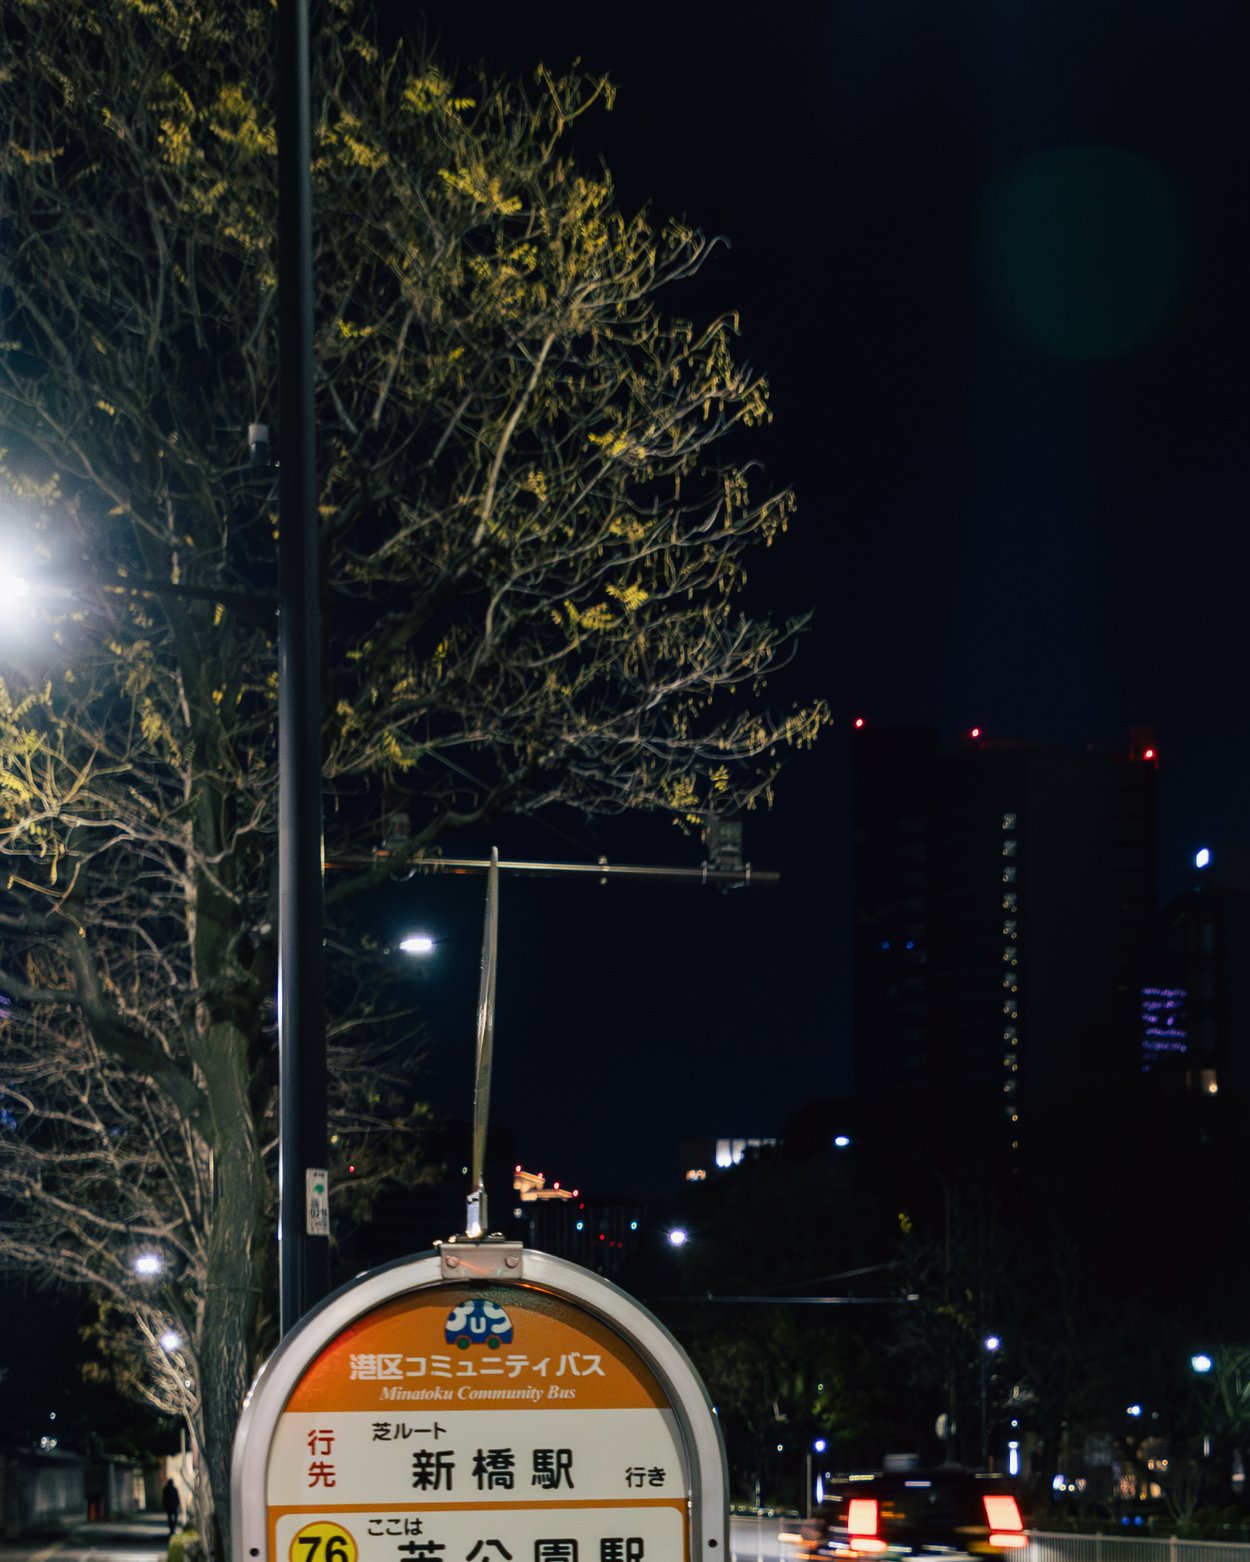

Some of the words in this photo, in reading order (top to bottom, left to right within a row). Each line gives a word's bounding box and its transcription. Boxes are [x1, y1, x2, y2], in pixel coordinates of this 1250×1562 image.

[349, 1353, 605, 1380] 港区コミュニティバス
[379, 1386, 453, 1401] Minatoku
[457, 1386, 544, 1403] Community
[547, 1386, 576, 1400] Bus
[371, 1422, 447, 1441] 芝ルート
[307, 1429, 336, 1488] 行先
[411, 1448, 575, 1491] 新橋駅
[625, 1467, 667, 1488] 行き
[367, 1518, 422, 1537] ここは
